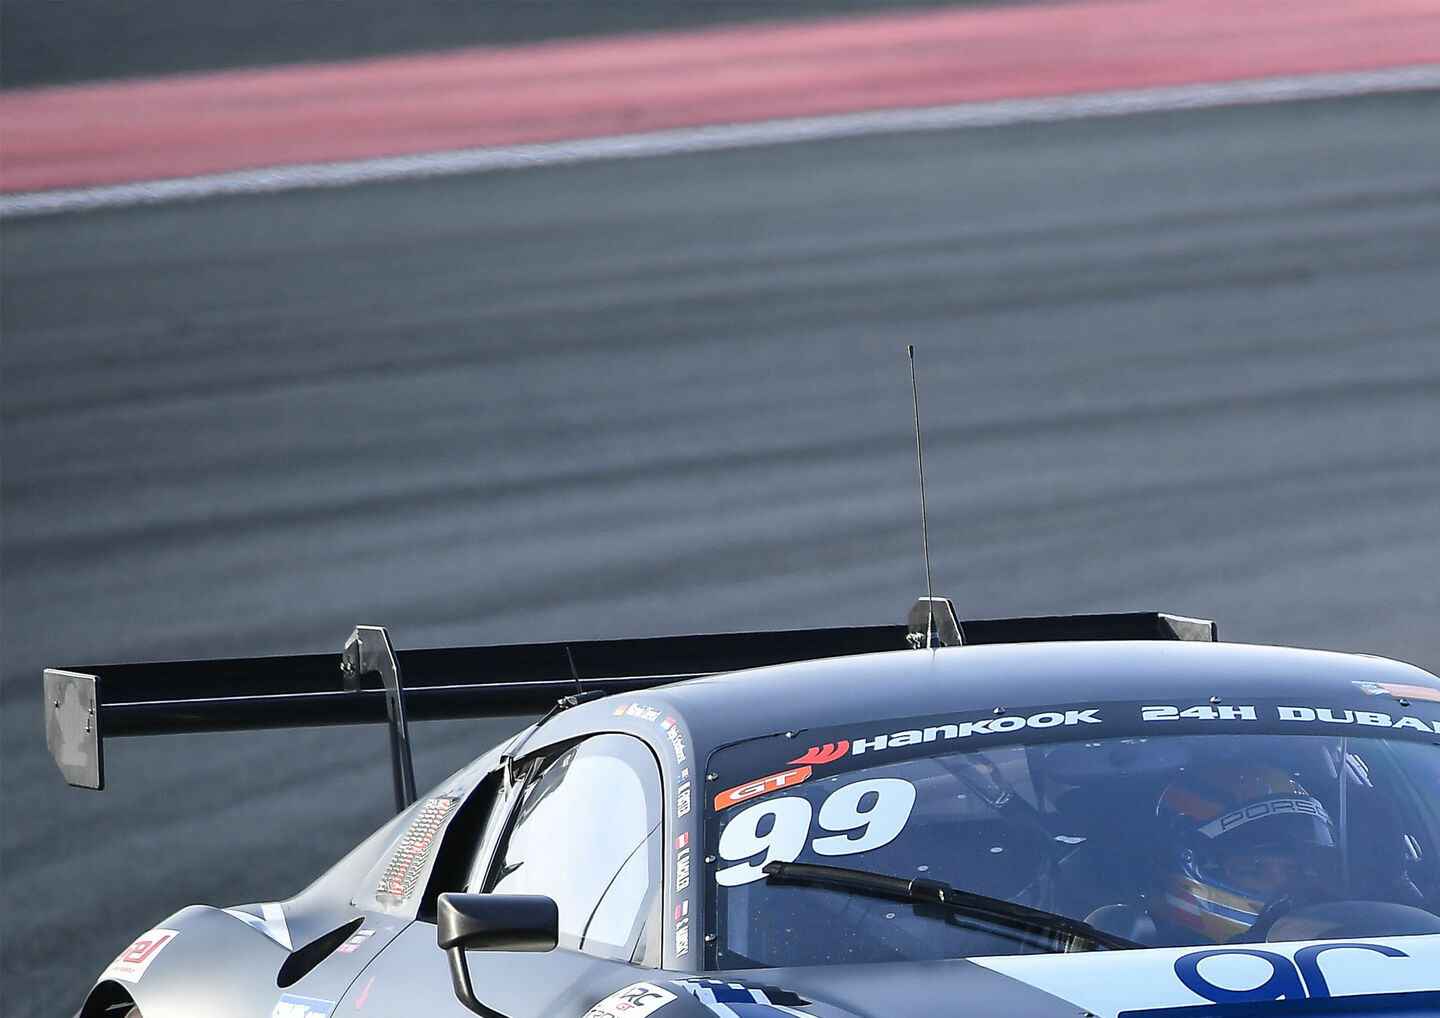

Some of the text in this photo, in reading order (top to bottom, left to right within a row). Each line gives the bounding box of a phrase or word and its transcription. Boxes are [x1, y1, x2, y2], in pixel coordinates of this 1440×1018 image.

[1141, 705, 1258, 722] 24H
[729, 771, 798, 802] GT
[715, 777, 917, 888] 99
